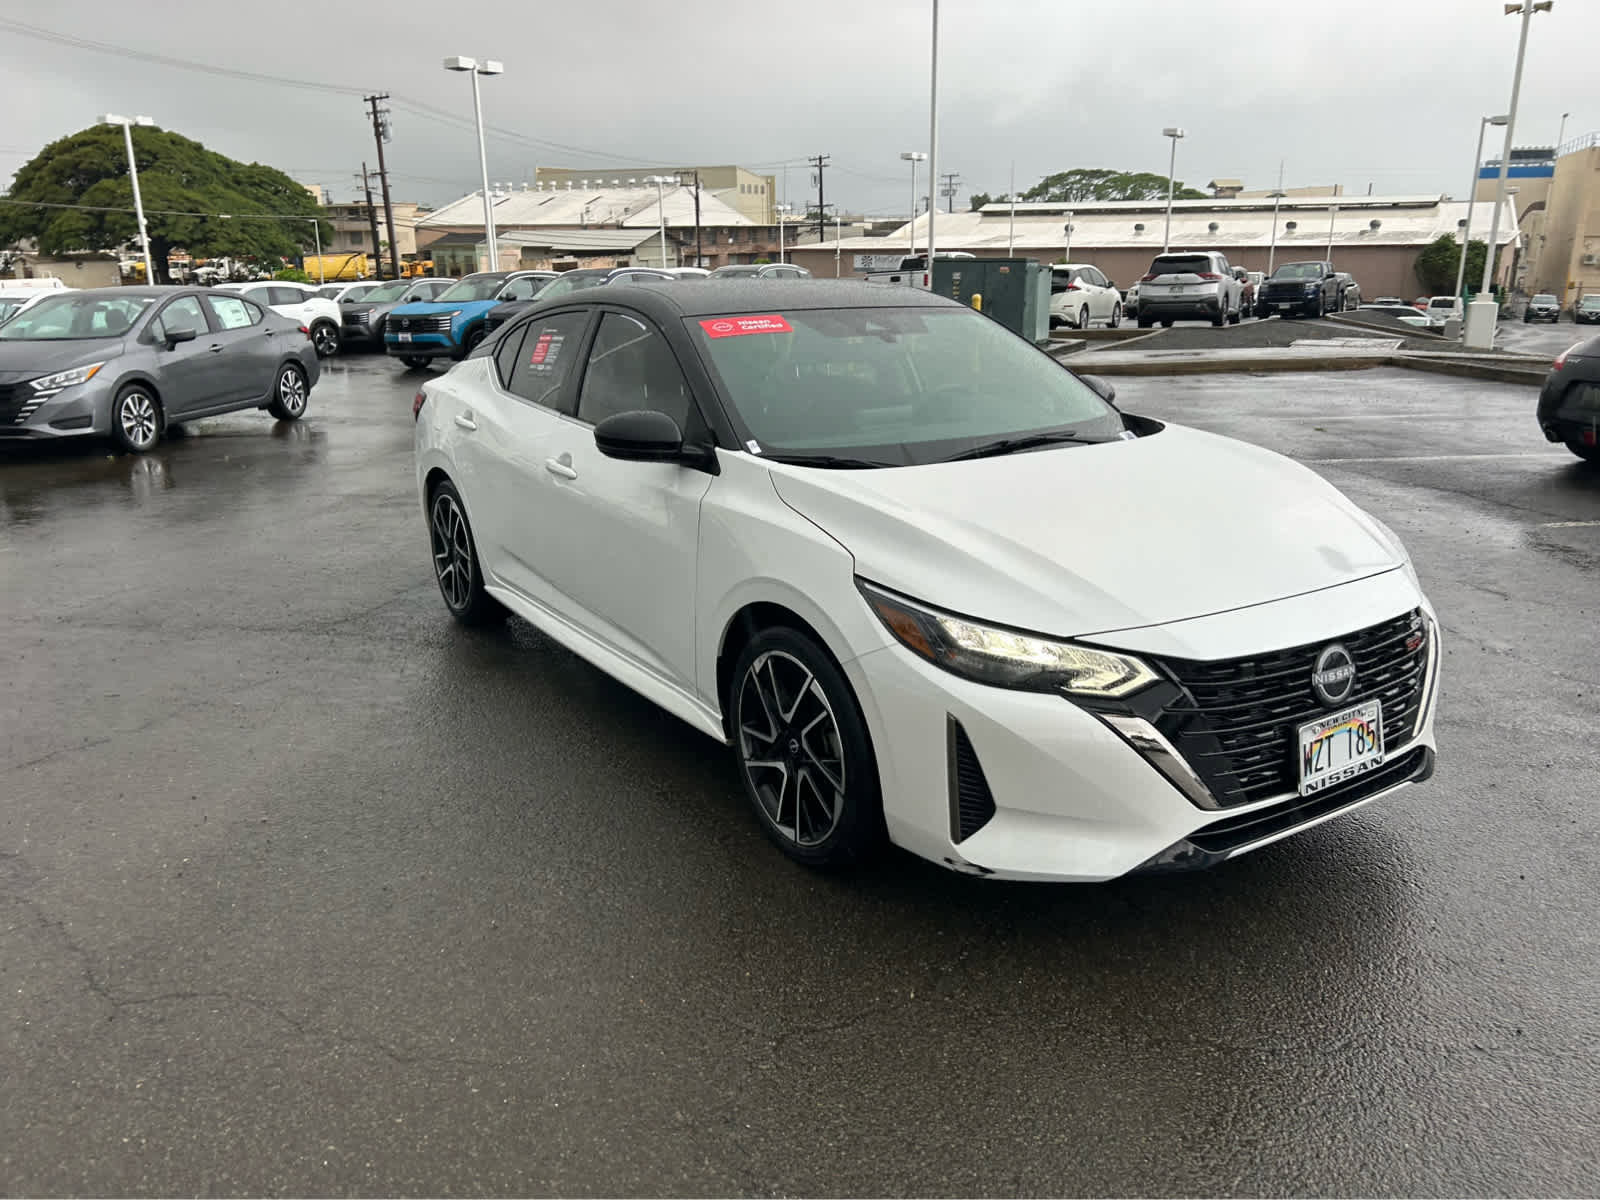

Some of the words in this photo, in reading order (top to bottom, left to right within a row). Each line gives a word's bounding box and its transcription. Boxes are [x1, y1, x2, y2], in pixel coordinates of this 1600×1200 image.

[1314, 664, 1355, 685] NISSAN
[1303, 733, 1335, 777] WZT
[1347, 719, 1375, 760] 185
[1305, 755, 1383, 795] NISSAN
